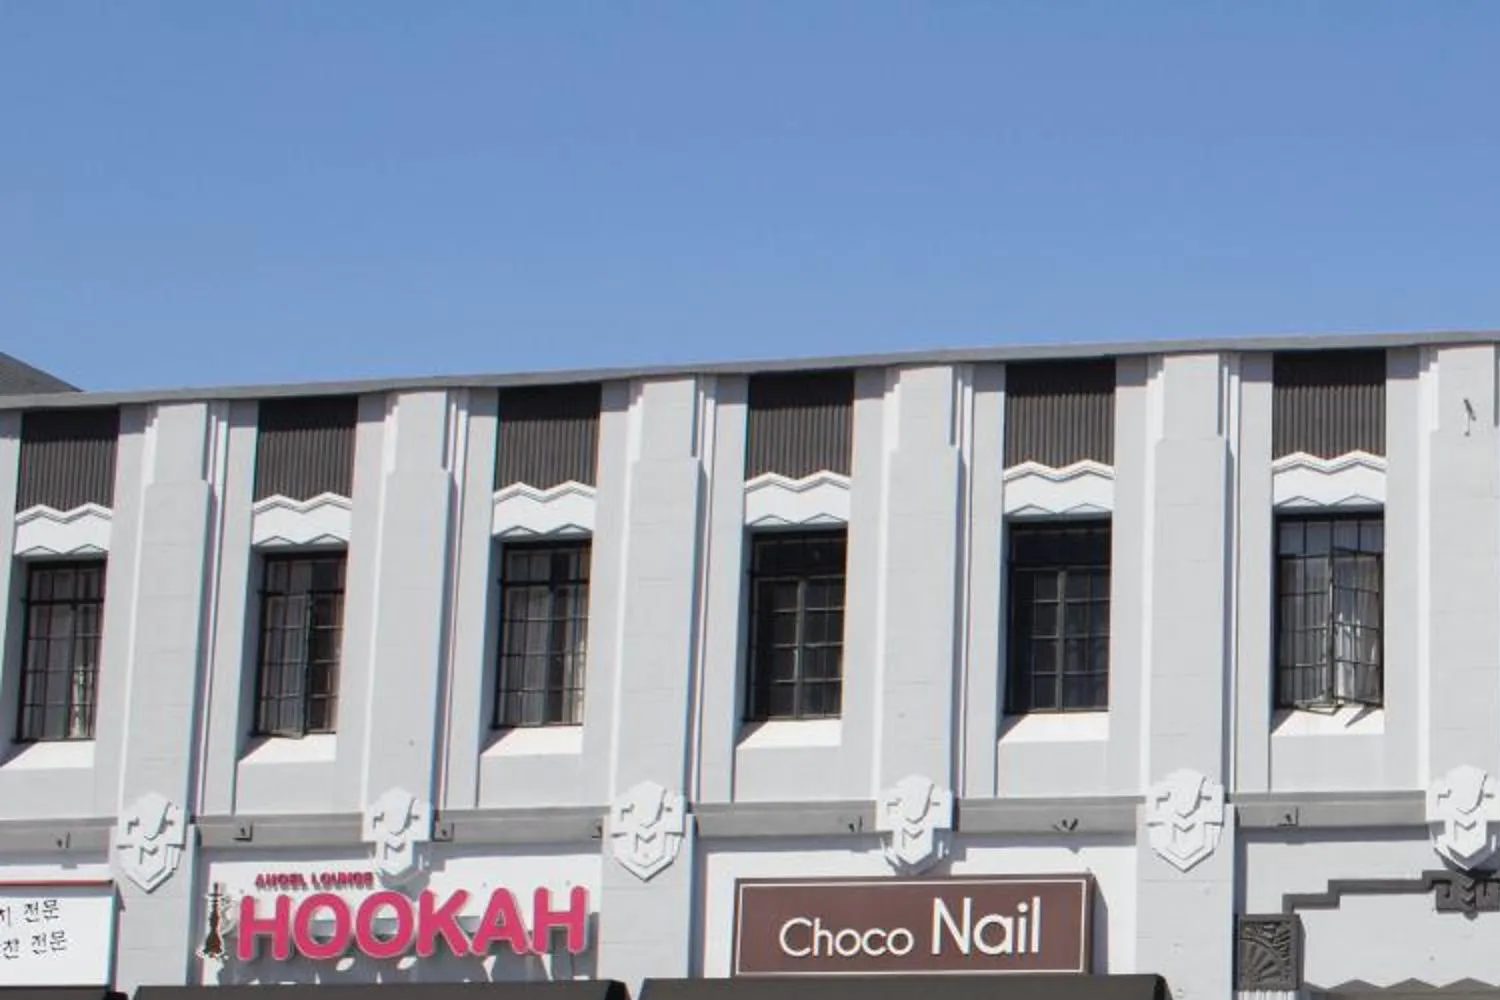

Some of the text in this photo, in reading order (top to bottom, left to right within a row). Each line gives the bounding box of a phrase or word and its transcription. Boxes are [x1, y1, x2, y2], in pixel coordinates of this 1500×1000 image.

[237, 885, 590, 960] HOOKAH
[779, 896, 1041, 957] Choco Nail
